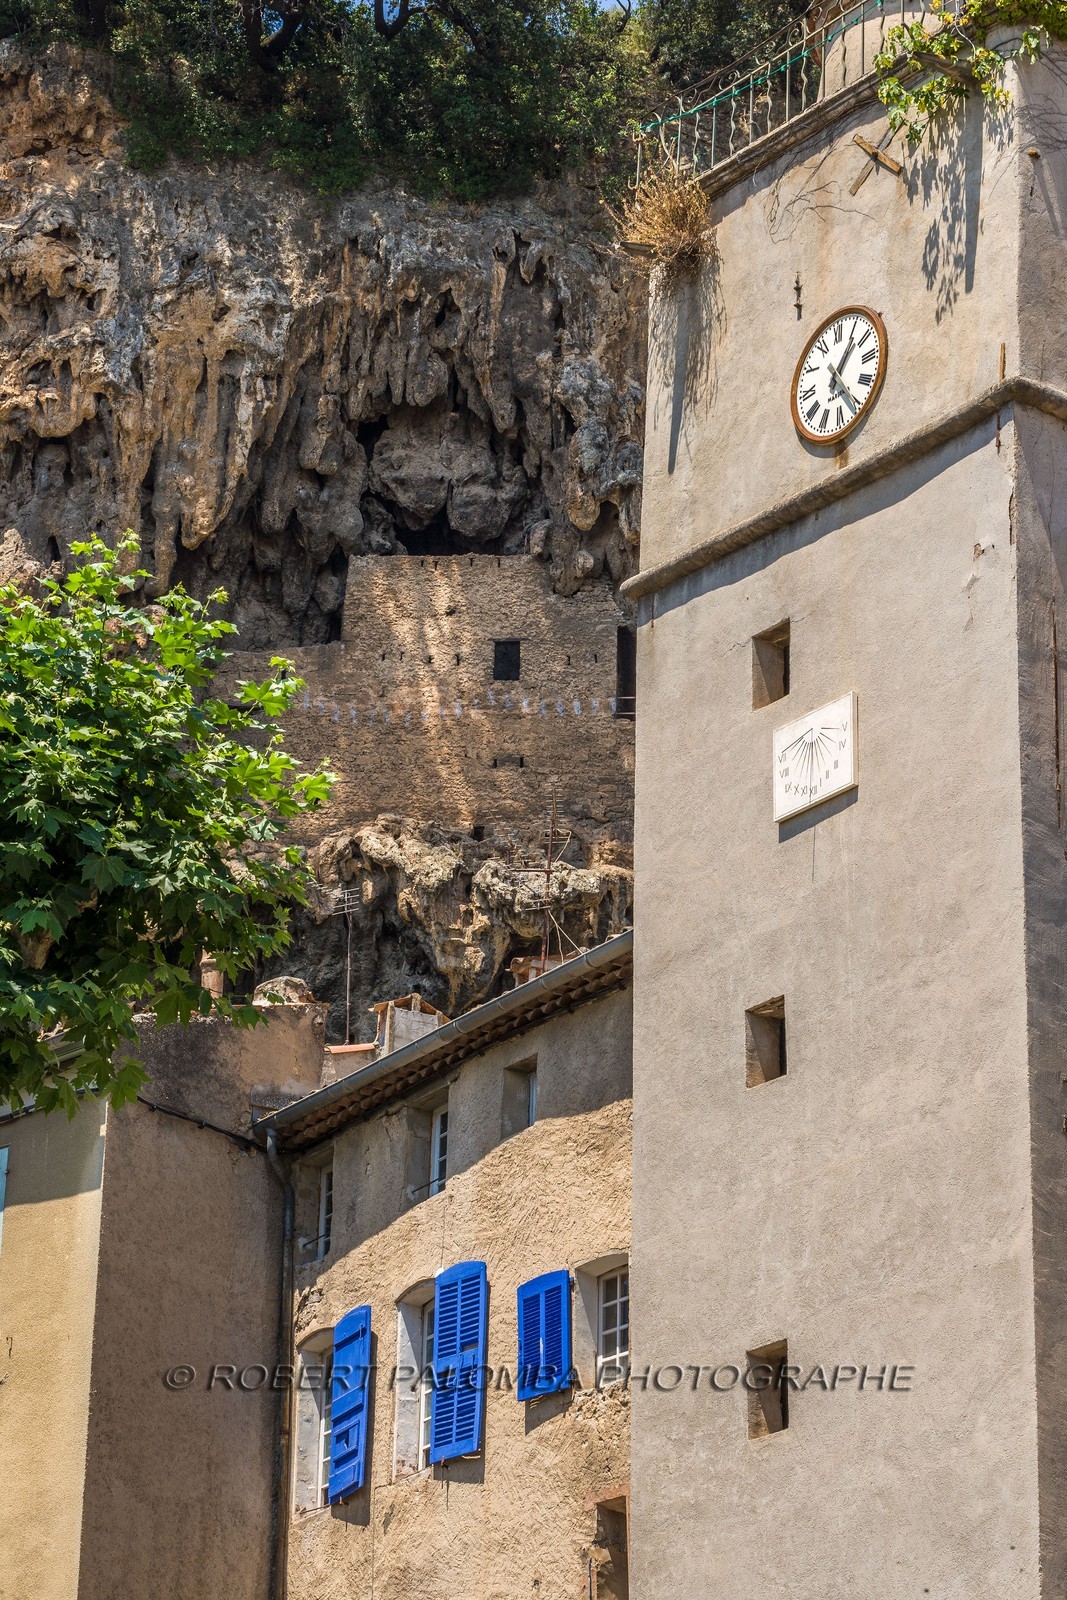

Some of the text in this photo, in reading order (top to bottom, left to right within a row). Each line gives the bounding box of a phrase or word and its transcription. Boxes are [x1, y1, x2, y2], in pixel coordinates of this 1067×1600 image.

[833, 323, 843, 346] XII
[857, 329, 871, 348] II
[817, 339, 829, 358] XI
[861, 348, 876, 364] III
[805, 364, 820, 373] X
[802, 384, 816, 401] IX
[842, 721, 848, 732] V
[839, 738, 847, 751] IV
